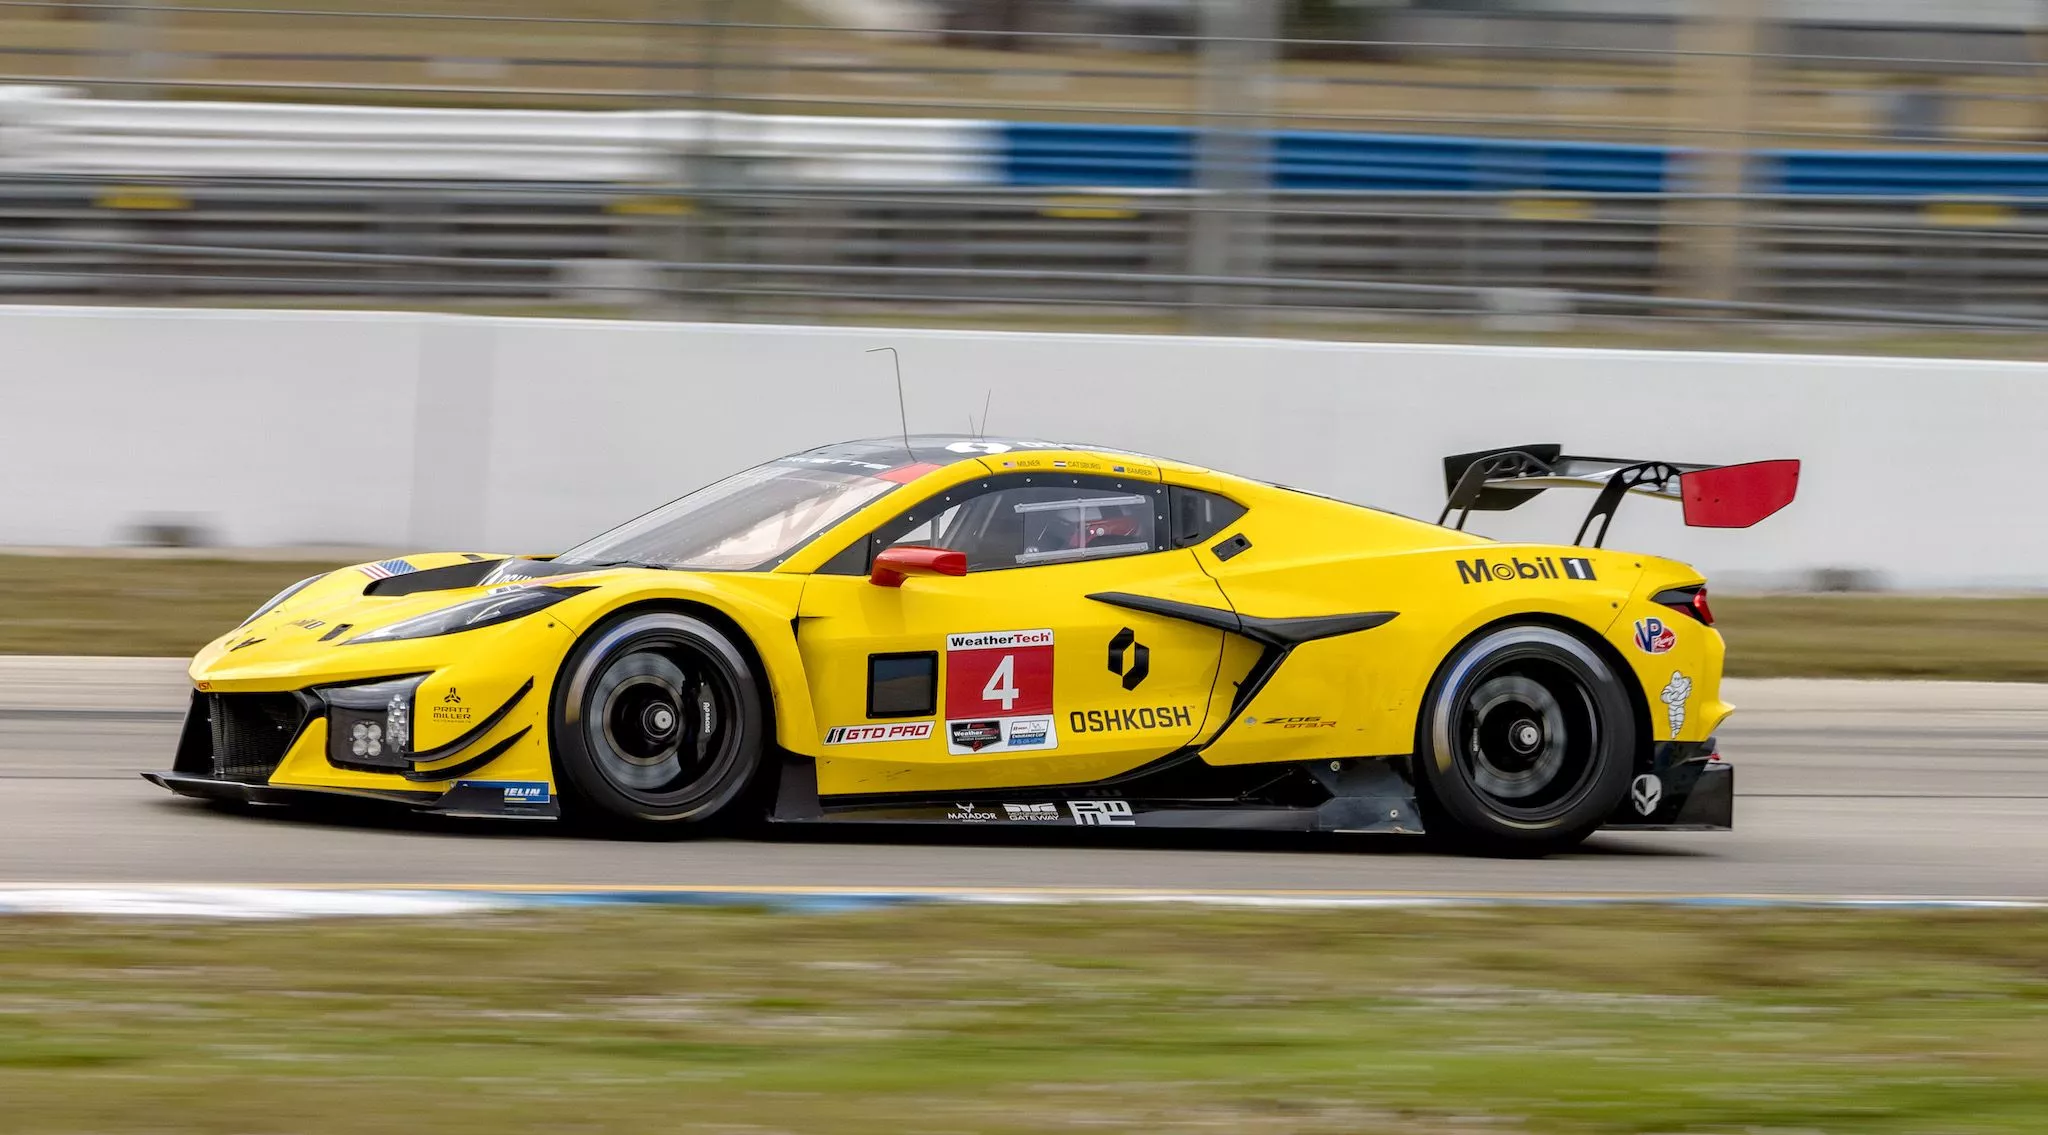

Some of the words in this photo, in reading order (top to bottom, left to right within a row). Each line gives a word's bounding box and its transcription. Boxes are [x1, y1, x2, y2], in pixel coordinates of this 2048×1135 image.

[1456, 557, 1559, 584] Mobil
[1568, 559, 1587, 579] 1
[951, 632, 1051, 647] WeatherTech
[1635, 618, 1662, 653] VP
[982, 655, 1019, 710] 4
[1070, 706, 1192, 733] OSHKOSH
[845, 728, 886, 740] GTD
[889, 725, 930, 738] PRO
[948, 812, 998, 822] MATADOR
[1009, 814, 1059, 822] GATEWAY
